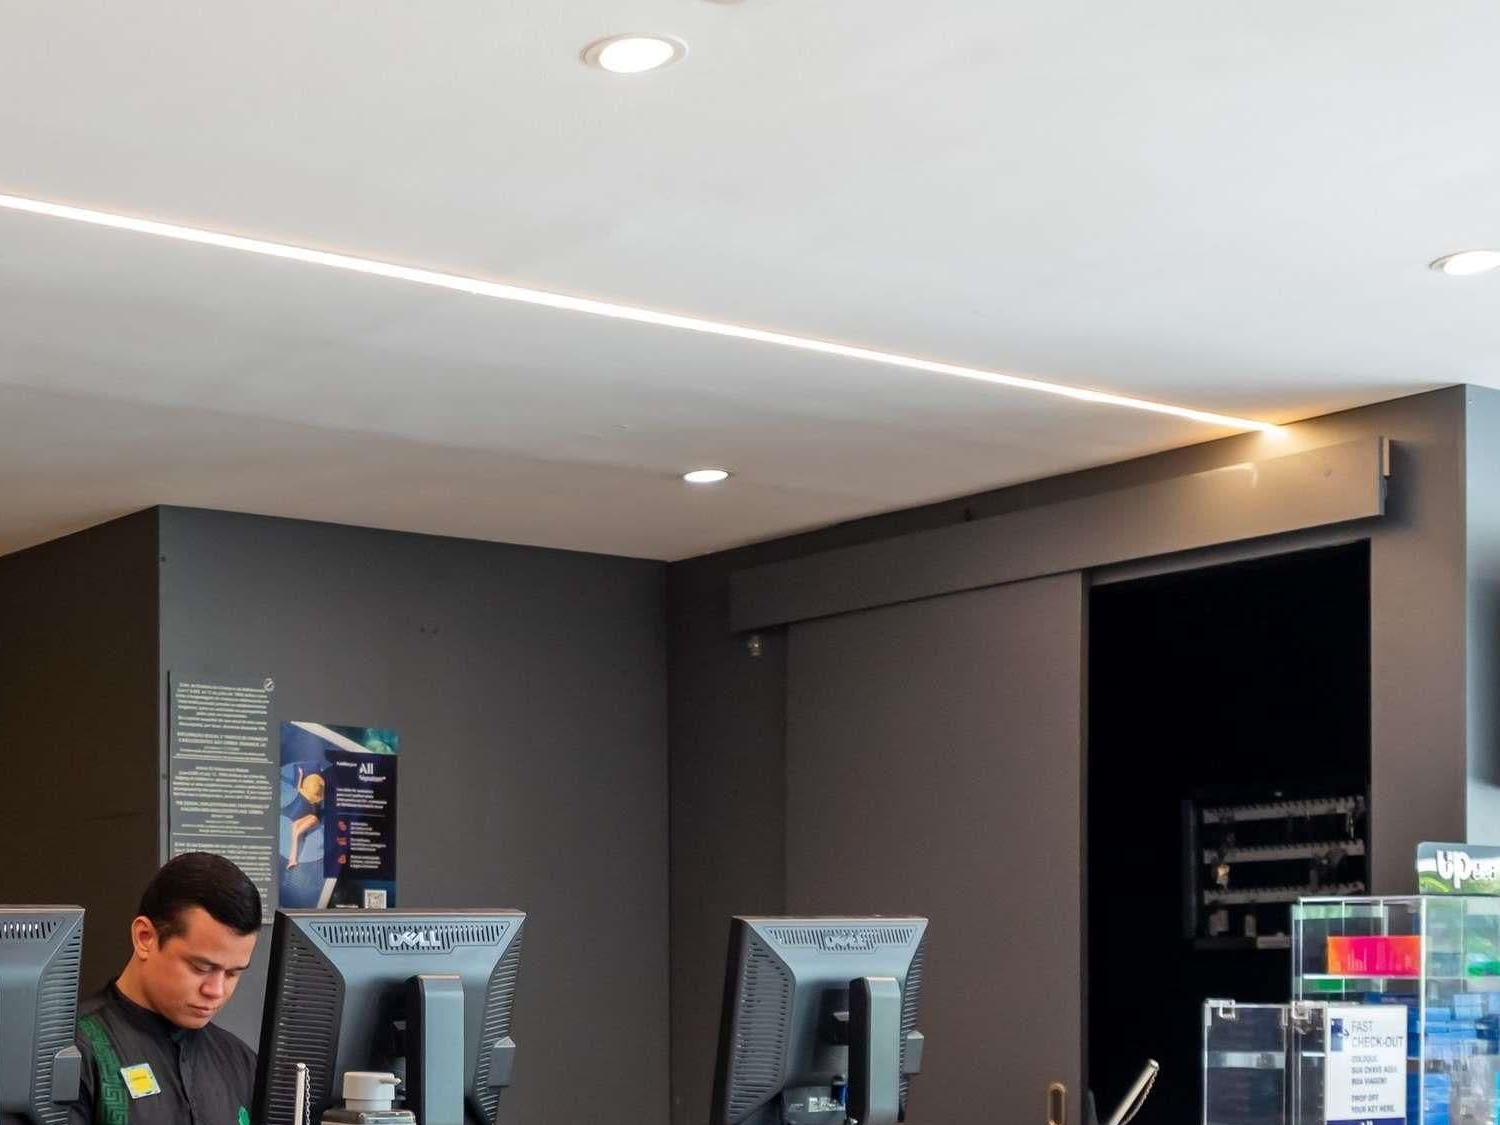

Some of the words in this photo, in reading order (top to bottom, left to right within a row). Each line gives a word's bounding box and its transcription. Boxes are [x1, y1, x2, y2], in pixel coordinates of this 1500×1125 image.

[388, 929, 441, 947] DELL
[1351, 1020, 1373, 1033] FAST
[1351, 1036, 1404, 1049] CHECK-OUT
